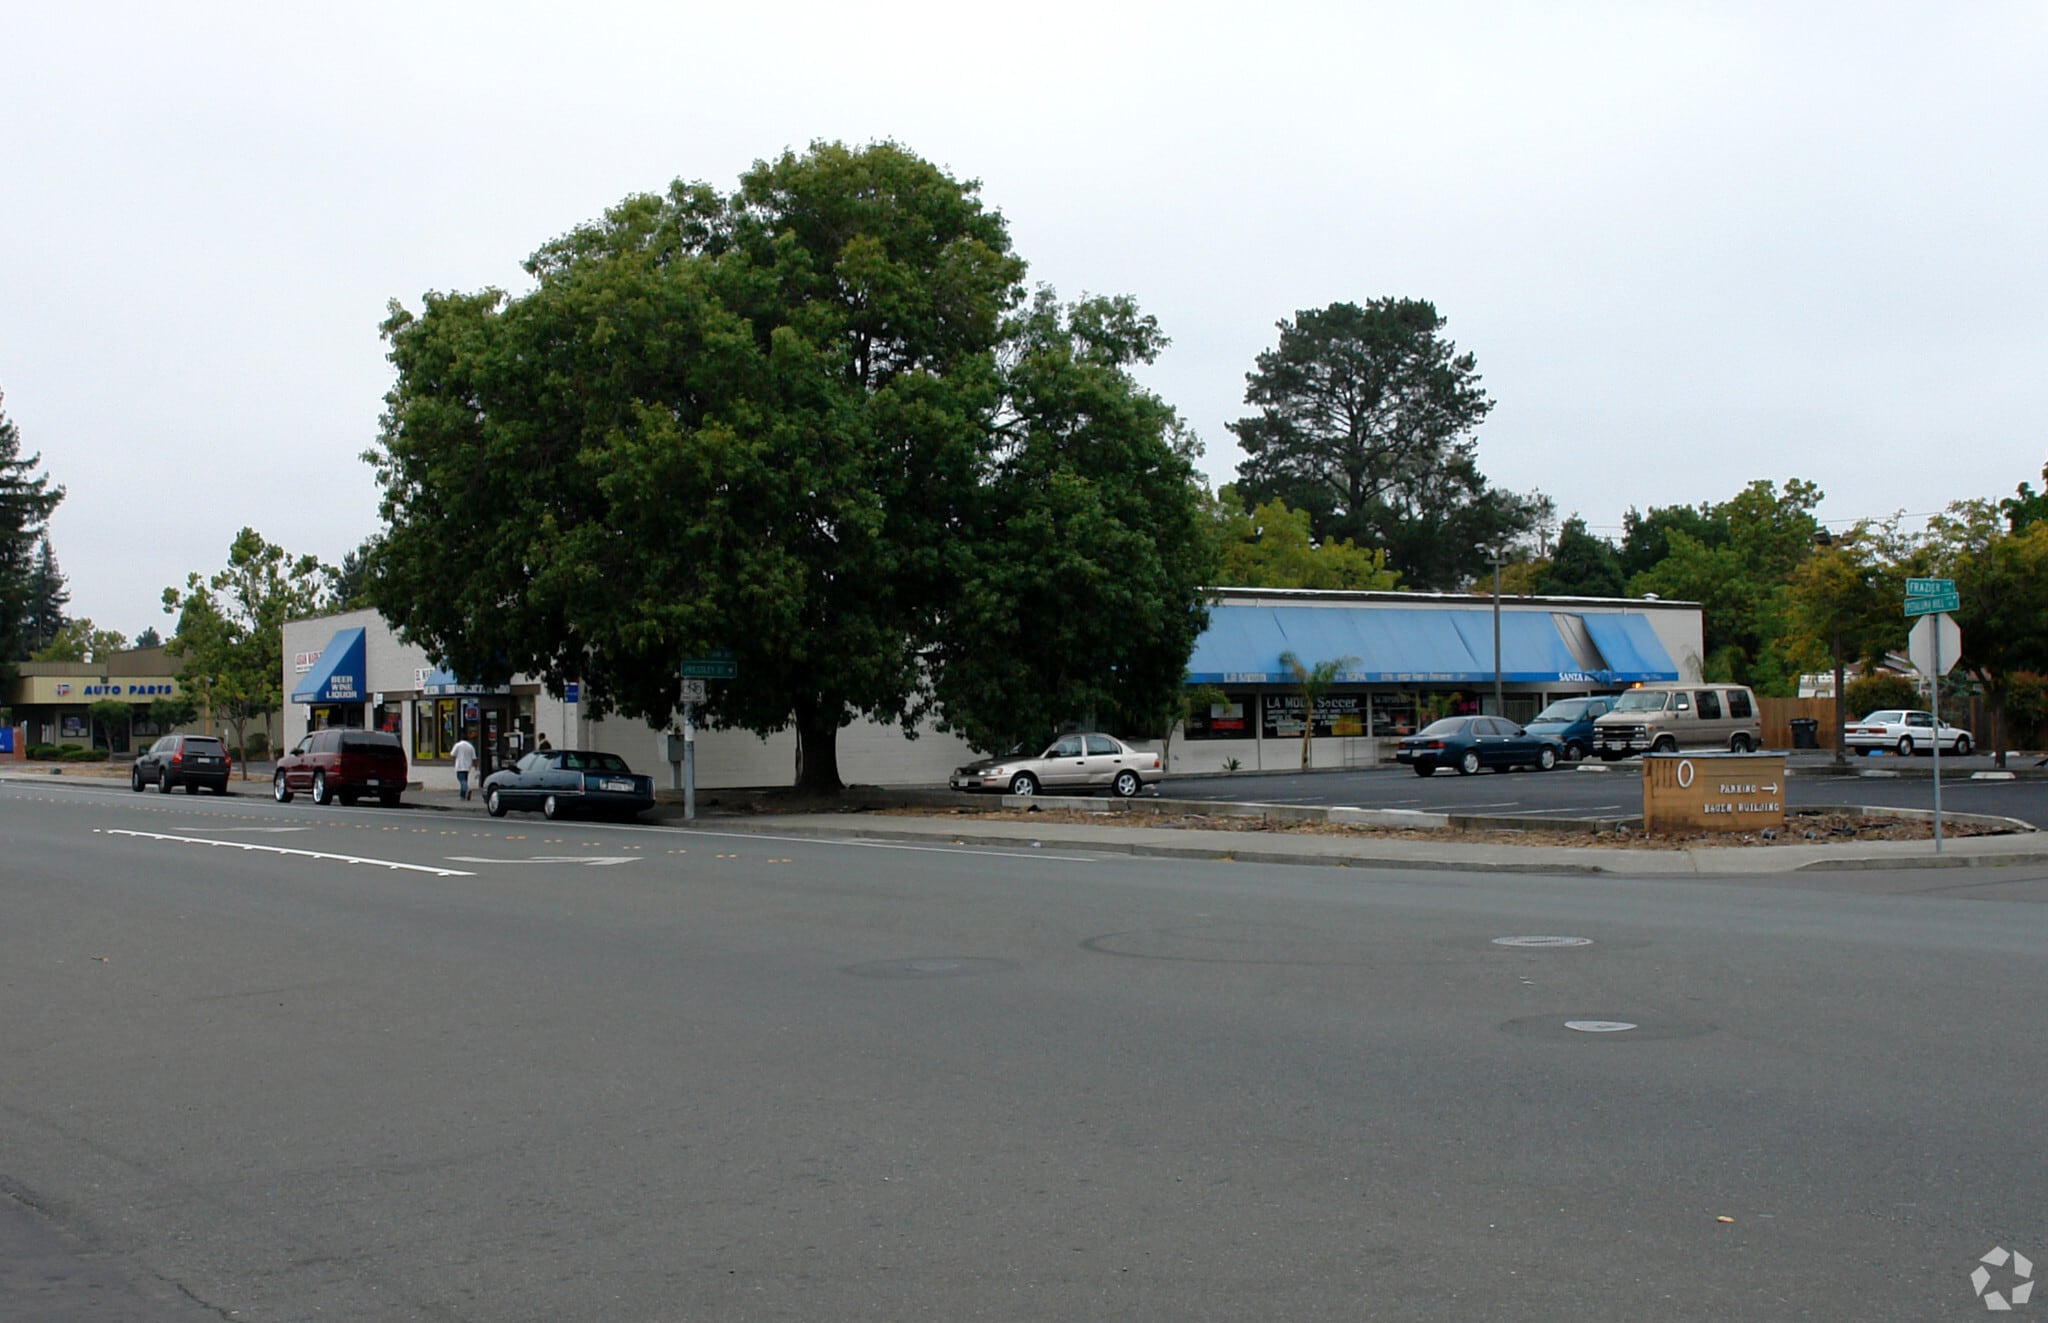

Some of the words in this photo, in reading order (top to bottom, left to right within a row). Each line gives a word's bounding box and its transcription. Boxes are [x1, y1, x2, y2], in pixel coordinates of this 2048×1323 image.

[1910, 582, 1941, 593] FRAZIER
[330, 675, 353, 684] BEER
[1558, 672, 1582, 682] SANTA
[84, 684, 122, 695] AUTO
[128, 684, 172, 695] PARTS
[331, 683, 353, 691] WINE
[326, 690, 358, 699] LIQUOR
[1266, 696, 1281, 709] LA
[1317, 696, 1358, 708] Soccer
[1720, 784, 1757, 794] PARKING
[1737, 802, 1780, 813] BUILDING
